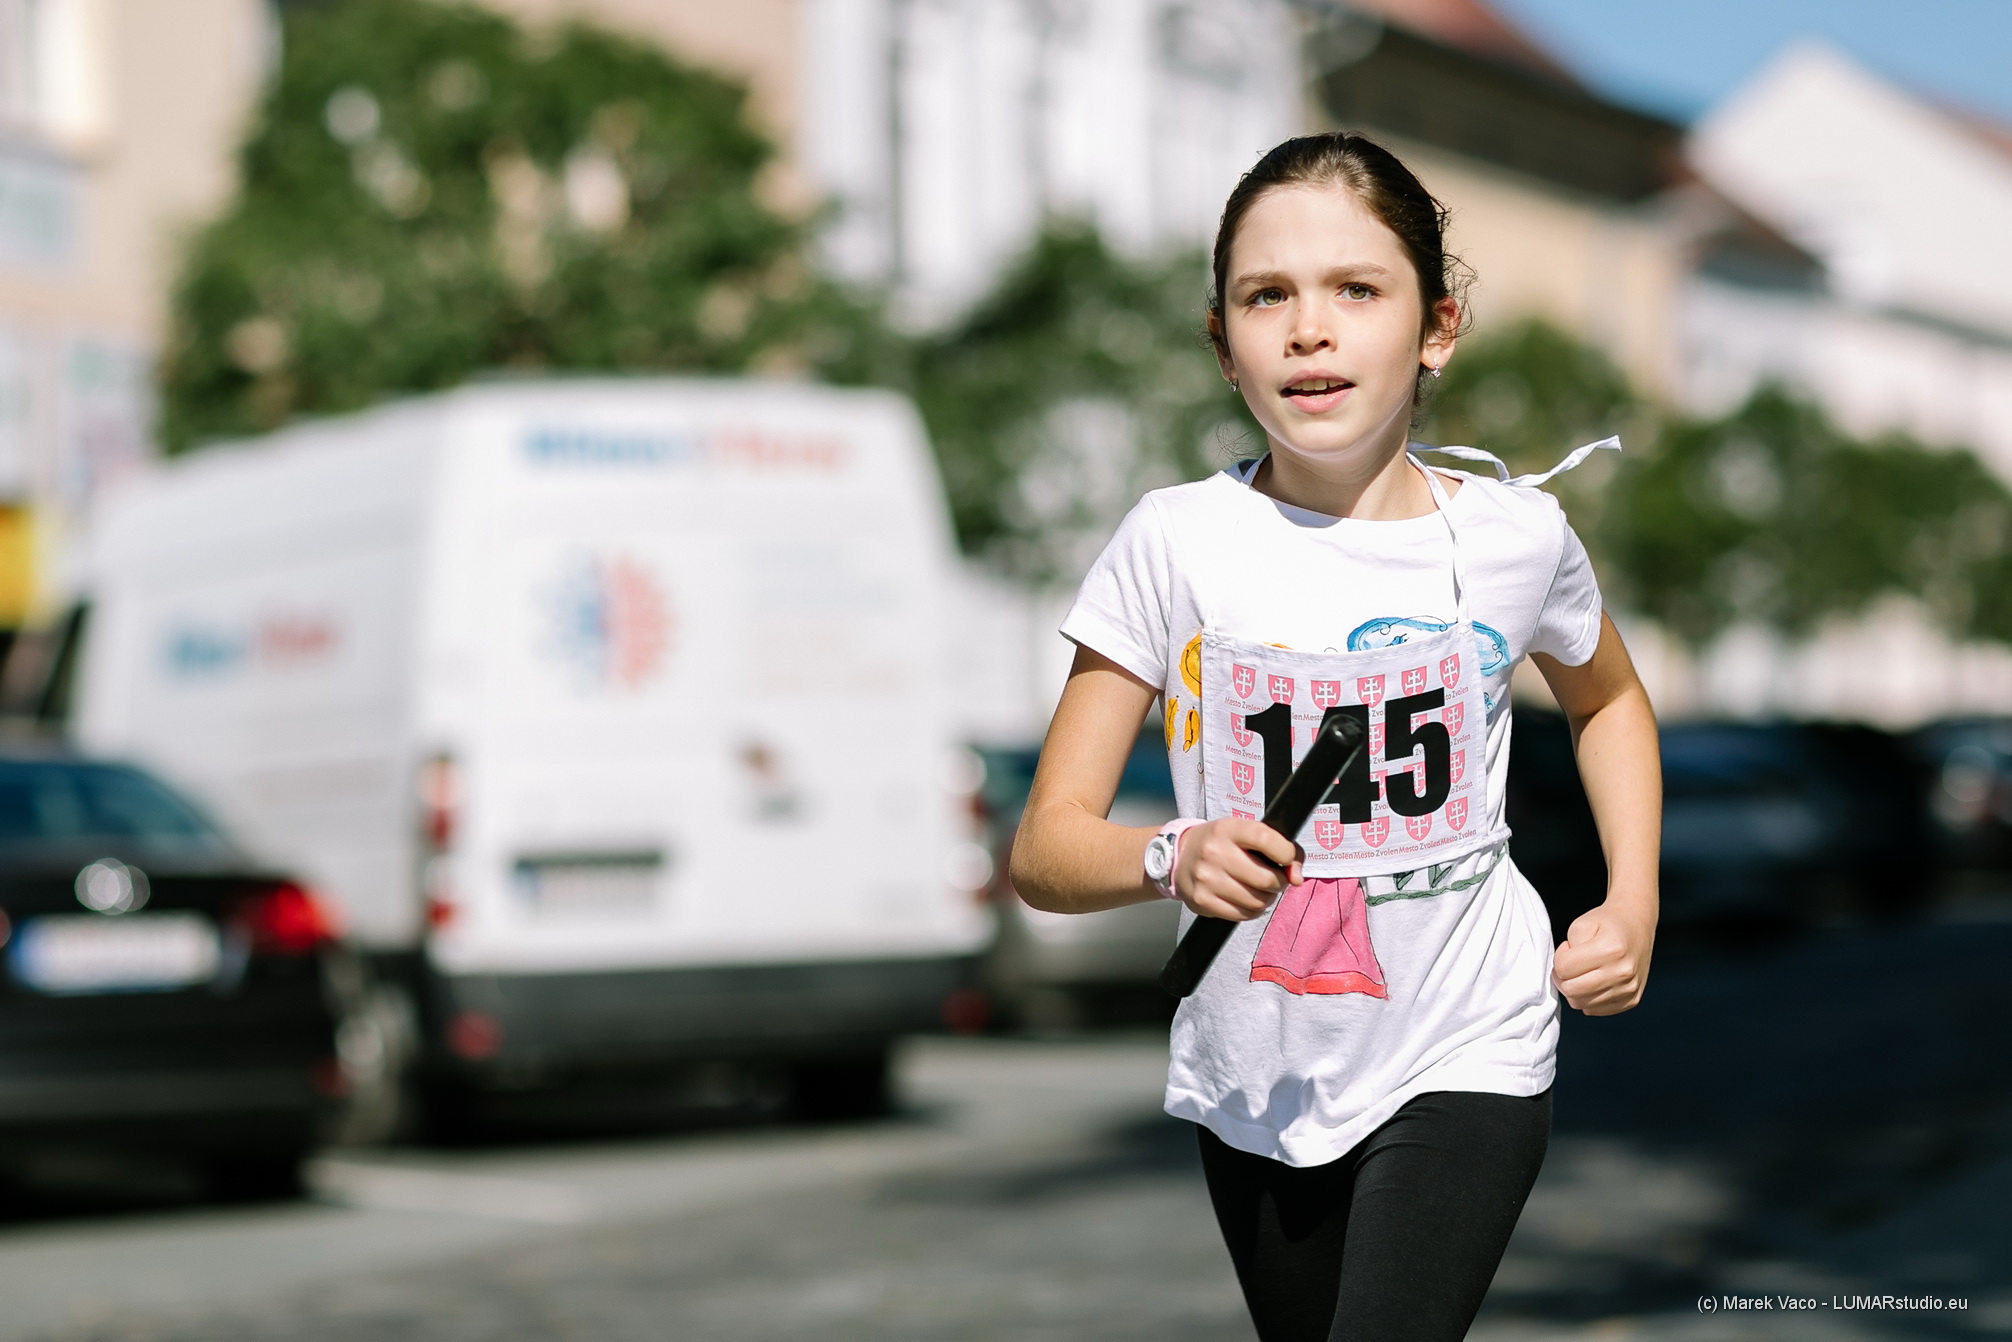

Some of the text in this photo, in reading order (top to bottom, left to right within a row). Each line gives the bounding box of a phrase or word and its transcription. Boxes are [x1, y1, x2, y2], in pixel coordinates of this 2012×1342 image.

[1225, 697, 1241, 707] Mesto
[1241, 699, 1261, 712] Zvolen
[1452, 686, 1469, 699] Zvolen
[1225, 745, 1242, 755] Mesto
[1242, 749, 1261, 761] Zvolen
[1453, 733, 1471, 745] Zvolen
[1245, 687, 1451, 824] 145
[1226, 793, 1242, 803] Mesto
[1242, 798, 1262, 808] Zvolen
[1454, 782, 1473, 793] Zvolen
[1329, 851, 1353, 860] Zvolen
[1354, 851, 1375, 859] Mesto
[1376, 847, 1399, 857] Zvolen
[1399, 845, 1419, 854] Mesto
[1420, 839, 1440, 850] Zvolen
[1440, 836, 1458, 846] Mesto
[1458, 829, 1477, 840] Zvolen
